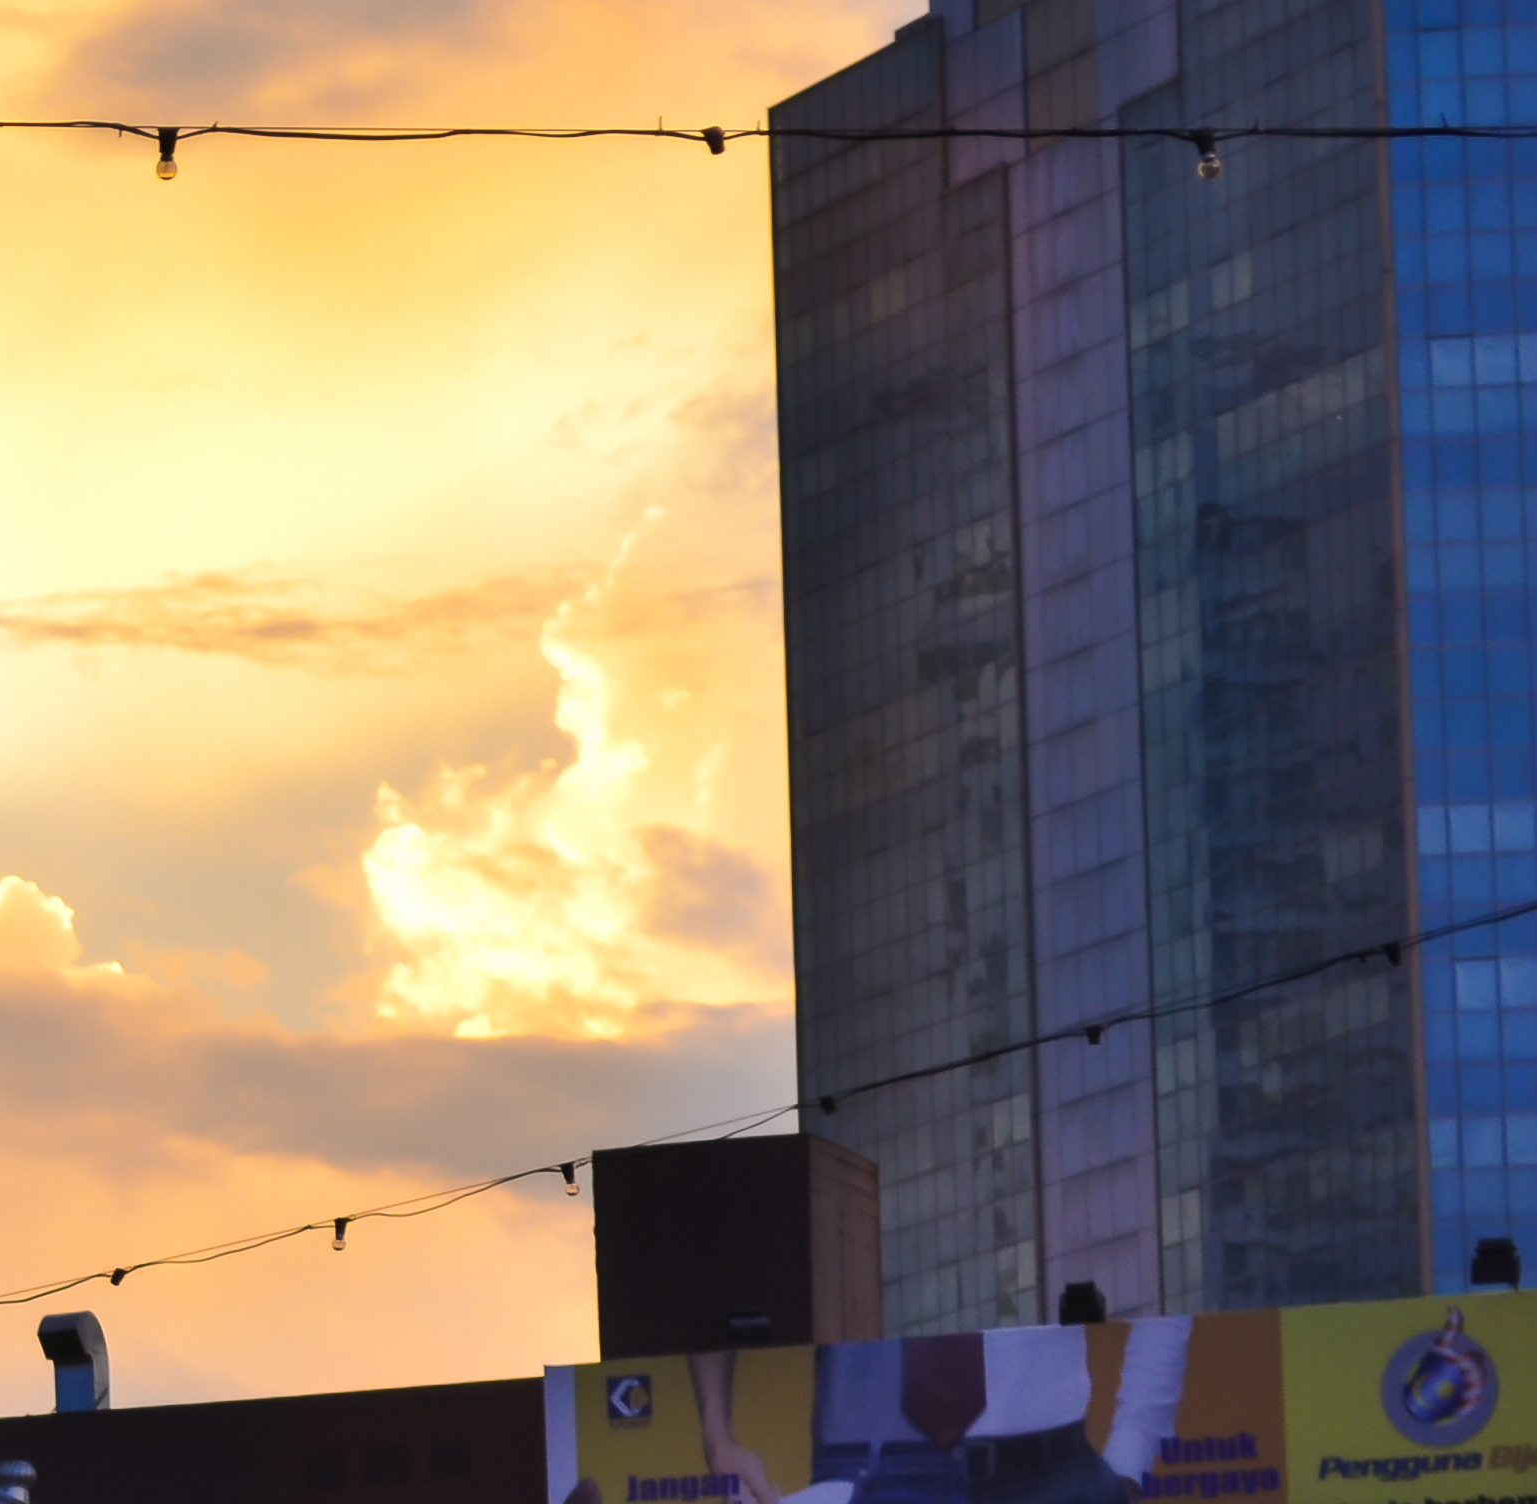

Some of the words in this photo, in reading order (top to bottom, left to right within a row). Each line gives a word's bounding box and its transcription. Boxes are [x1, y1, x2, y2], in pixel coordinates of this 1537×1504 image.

[1161, 1432, 1258, 1465] Untuk
[1319, 1452, 1483, 1481] Pengguna
[627, 1473, 740, 1503] Jangan
[1141, 1467, 1279, 1498] bergaya
